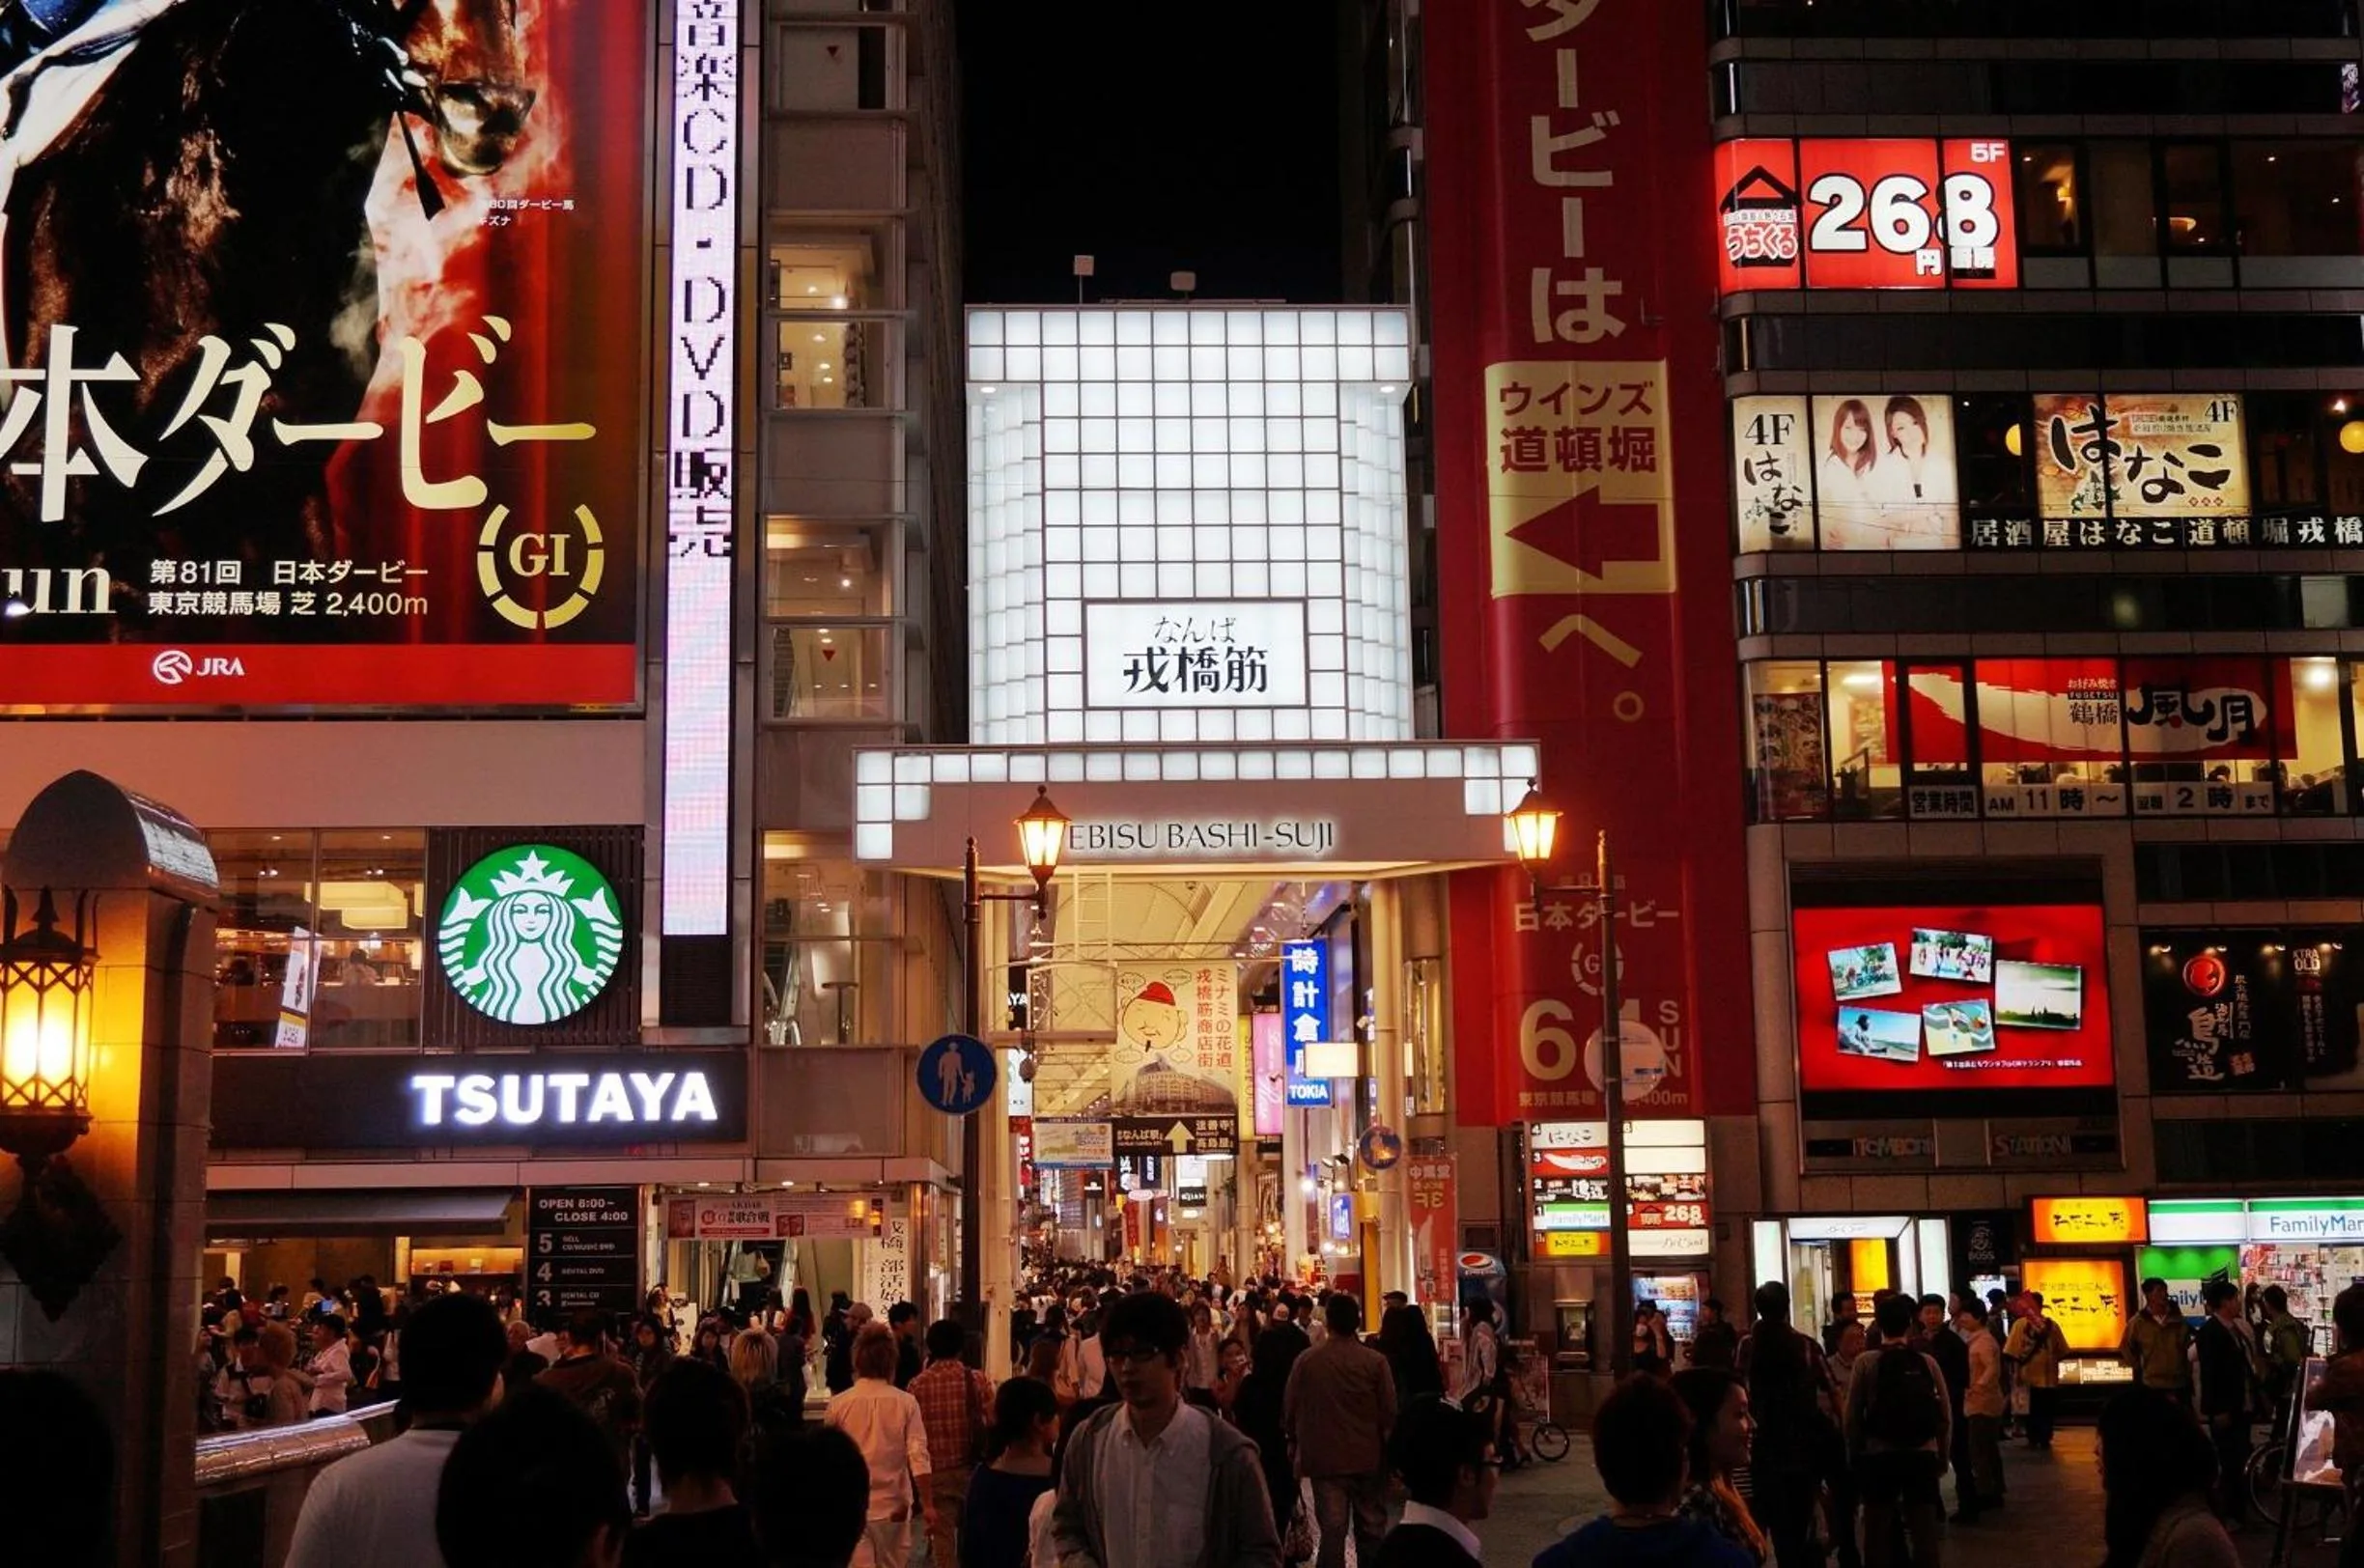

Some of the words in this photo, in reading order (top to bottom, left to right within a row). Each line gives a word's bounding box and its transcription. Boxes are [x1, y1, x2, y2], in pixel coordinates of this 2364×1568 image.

[1971, 143, 2006, 162] 5F
[479, 199, 575, 210] 80回ダービー馬
[1809, 173, 2001, 254] 268
[1726, 224, 1798, 260] うちくる
[1916, 249, 1943, 275] 円
[1500, 381, 1654, 416] ウインズ
[2205, 401, 2239, 423] 4F
[1745, 413, 1795, 445] 4F
[1500, 426, 1657, 473] 道頓堀
[2049, 404, 2232, 504] はなこ
[1744, 451, 1804, 535] はなこ
[508, 533, 571, 577] GI
[150, 559, 242, 586] 第81回
[273, 559, 429, 586] 日本ダービー
[148, 591, 281, 616] 東京競馬場
[291, 592, 317, 616] 芝
[325, 592, 429, 617] 2,400m
[1154, 615, 1237, 644] なんば
[196, 656, 245, 677] JRA
[1122, 645, 1269, 694] 戎橋筋
[2068, 678, 2118, 689] お好み焼き
[2069, 702, 2120, 726] 鶴橋
[2125, 679, 2257, 742] 風月
[1911, 794, 1975, 815] 営業時間
[1987, 798, 2015, 812] AM
[1068, 823, 1159, 851] EBISU
[1167, 822, 1258, 850] BASHI
[1514, 899, 1680, 933] 日本ダービー
[2294, 959, 2322, 971] OLD
[1658, 999, 1682, 1078] SUN
[411, 1072, 718, 1125] TSUTAYA
[1288, 1084, 1329, 1100] TOKIA
[1626, 1089, 1689, 1108] ,400m
[539, 1199, 575, 1209] OPEN
[554, 1211, 597, 1222] CLOSE
[600, 1211, 629, 1221] 4:00
[1664, 1204, 1703, 1222] 268
[538, 1233, 552, 1253] 5
[537, 1261, 552, 1282] 4
[2168, 1290, 2206, 1309] mily
